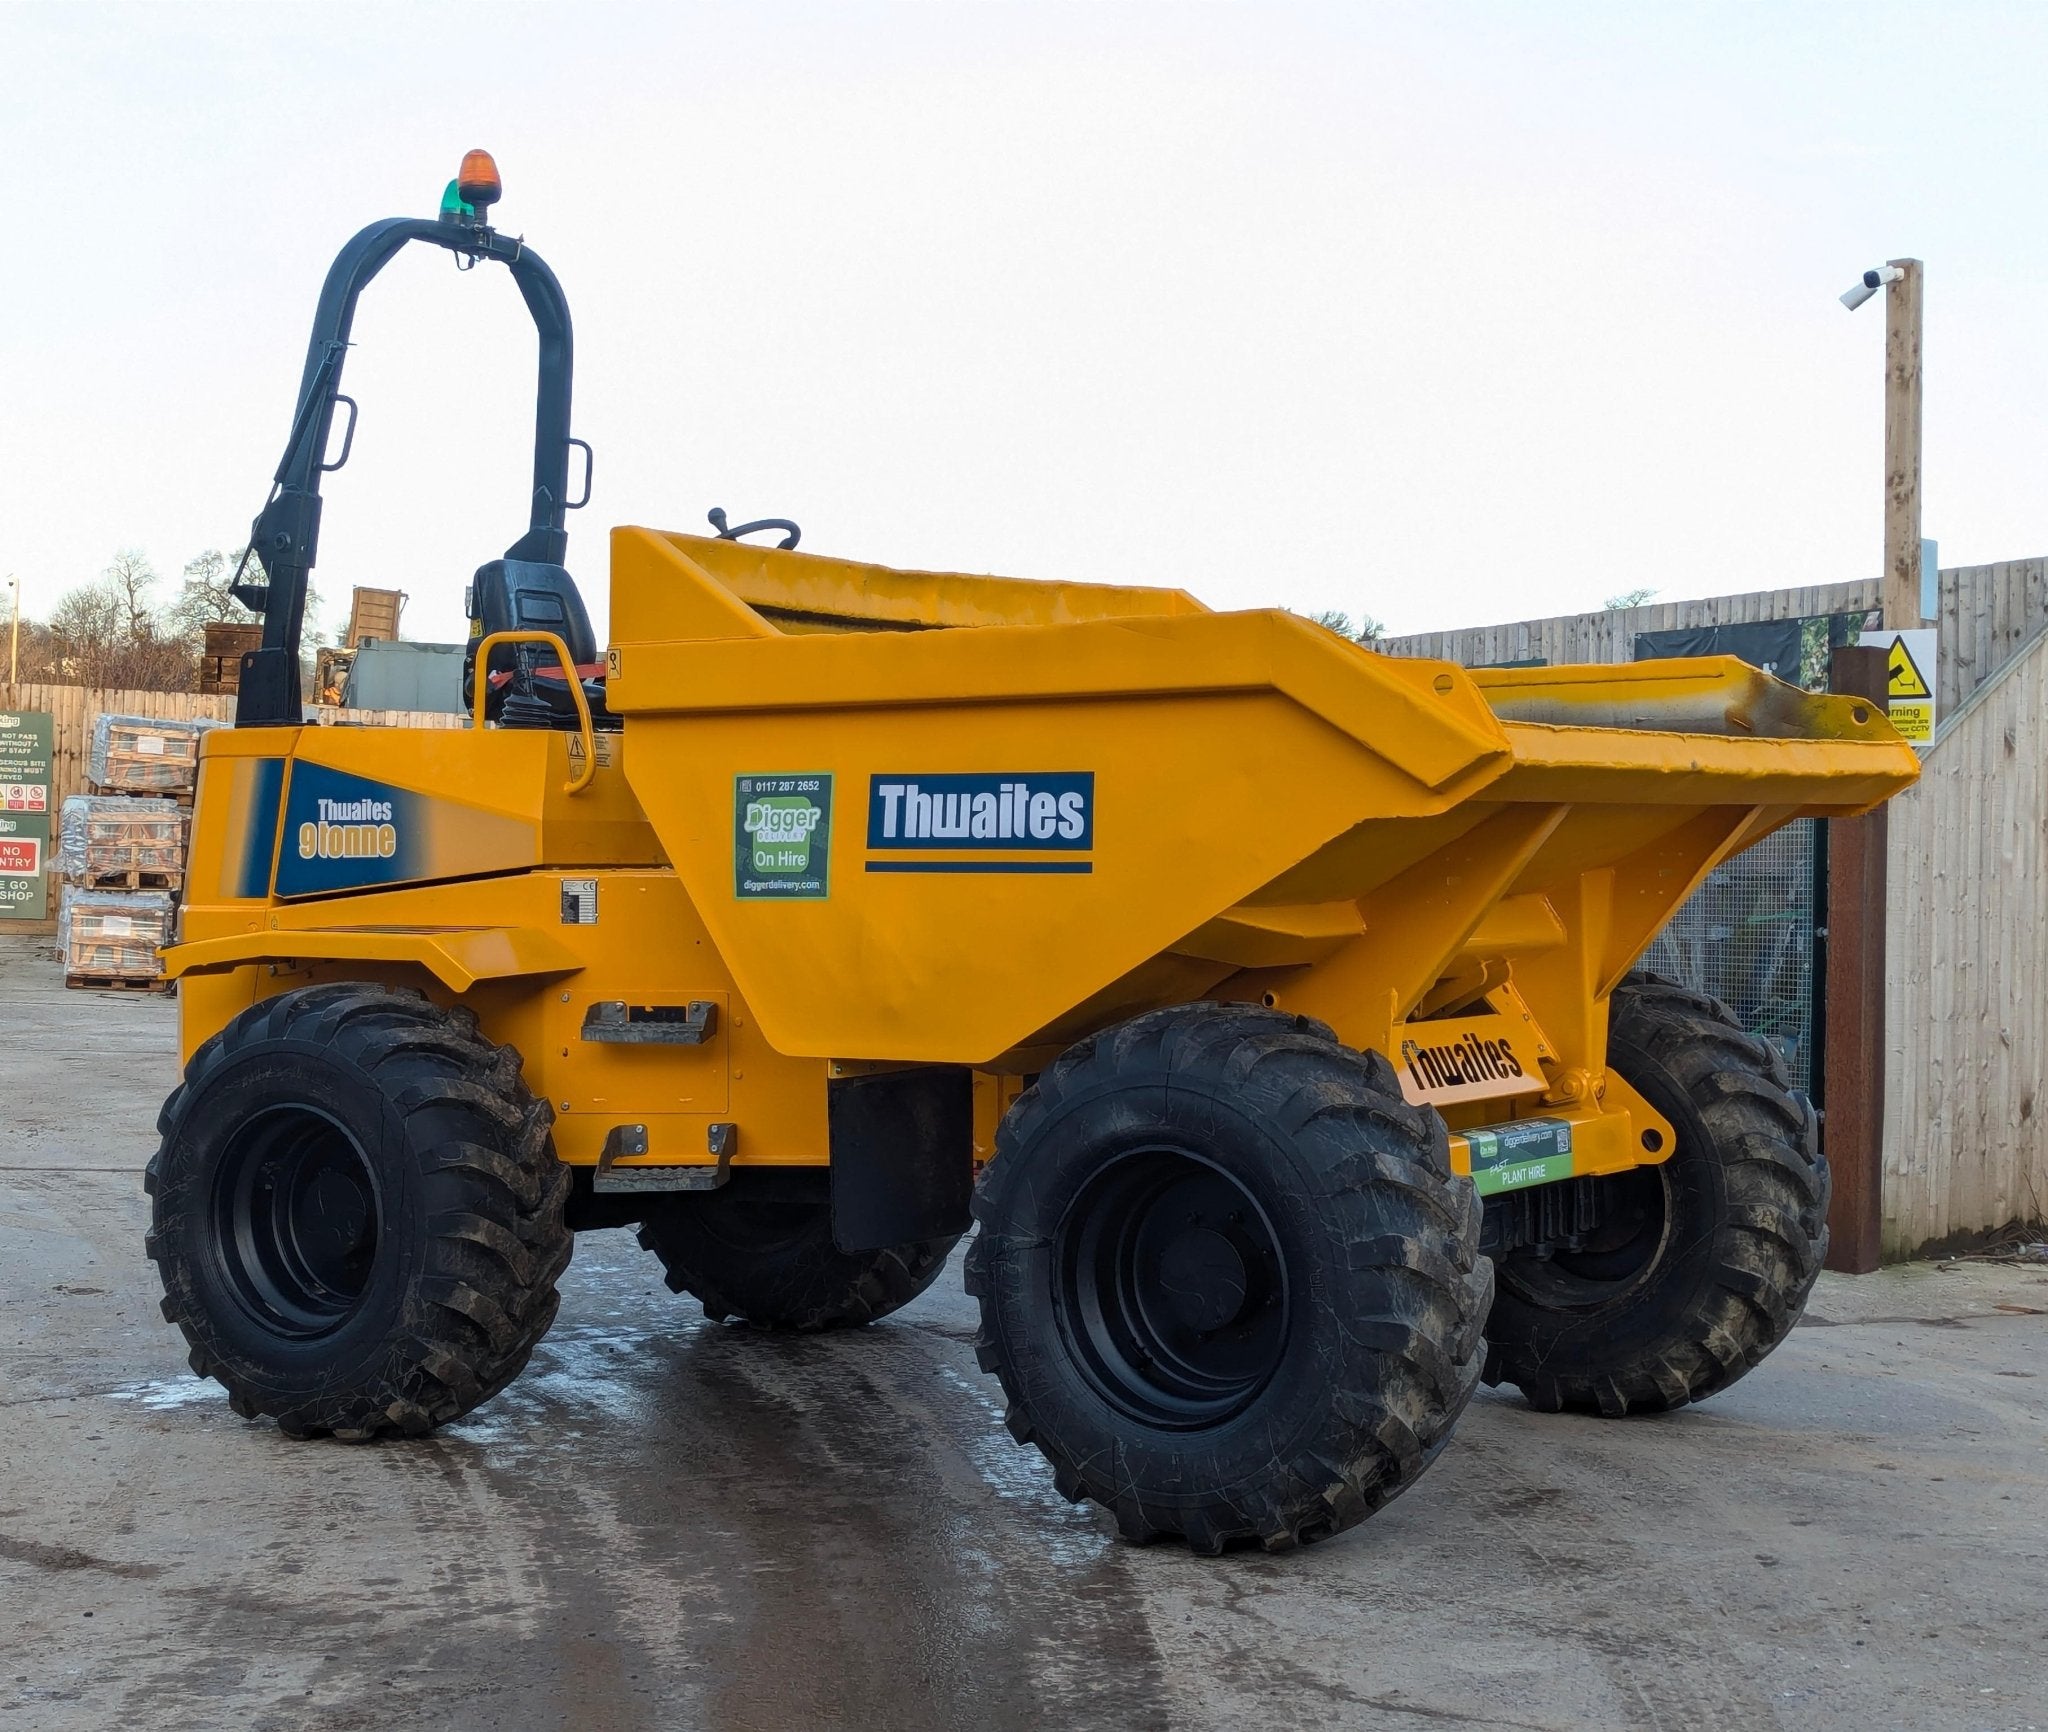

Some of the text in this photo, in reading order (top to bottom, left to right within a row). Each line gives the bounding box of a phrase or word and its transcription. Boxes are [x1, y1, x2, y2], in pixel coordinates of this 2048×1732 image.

[1888, 706, 1920, 719] rning
[23, 767, 45, 775] MUST
[755, 780, 820, 792] 0117 287 2652
[318, 799, 392, 821] Thwaites
[879, 783, 1085, 840] Thwaites
[744, 803, 821, 832] Digger
[3, 847, 20, 855] NO
[755, 851, 806, 867] On Hire
[10, 881, 28, 890] GO
[744, 880, 820, 891] diggerdelivery.com
[1402, 1033, 1523, 1090] Thwaites
[1502, 1164, 1546, 1185] PLANT HIRE
